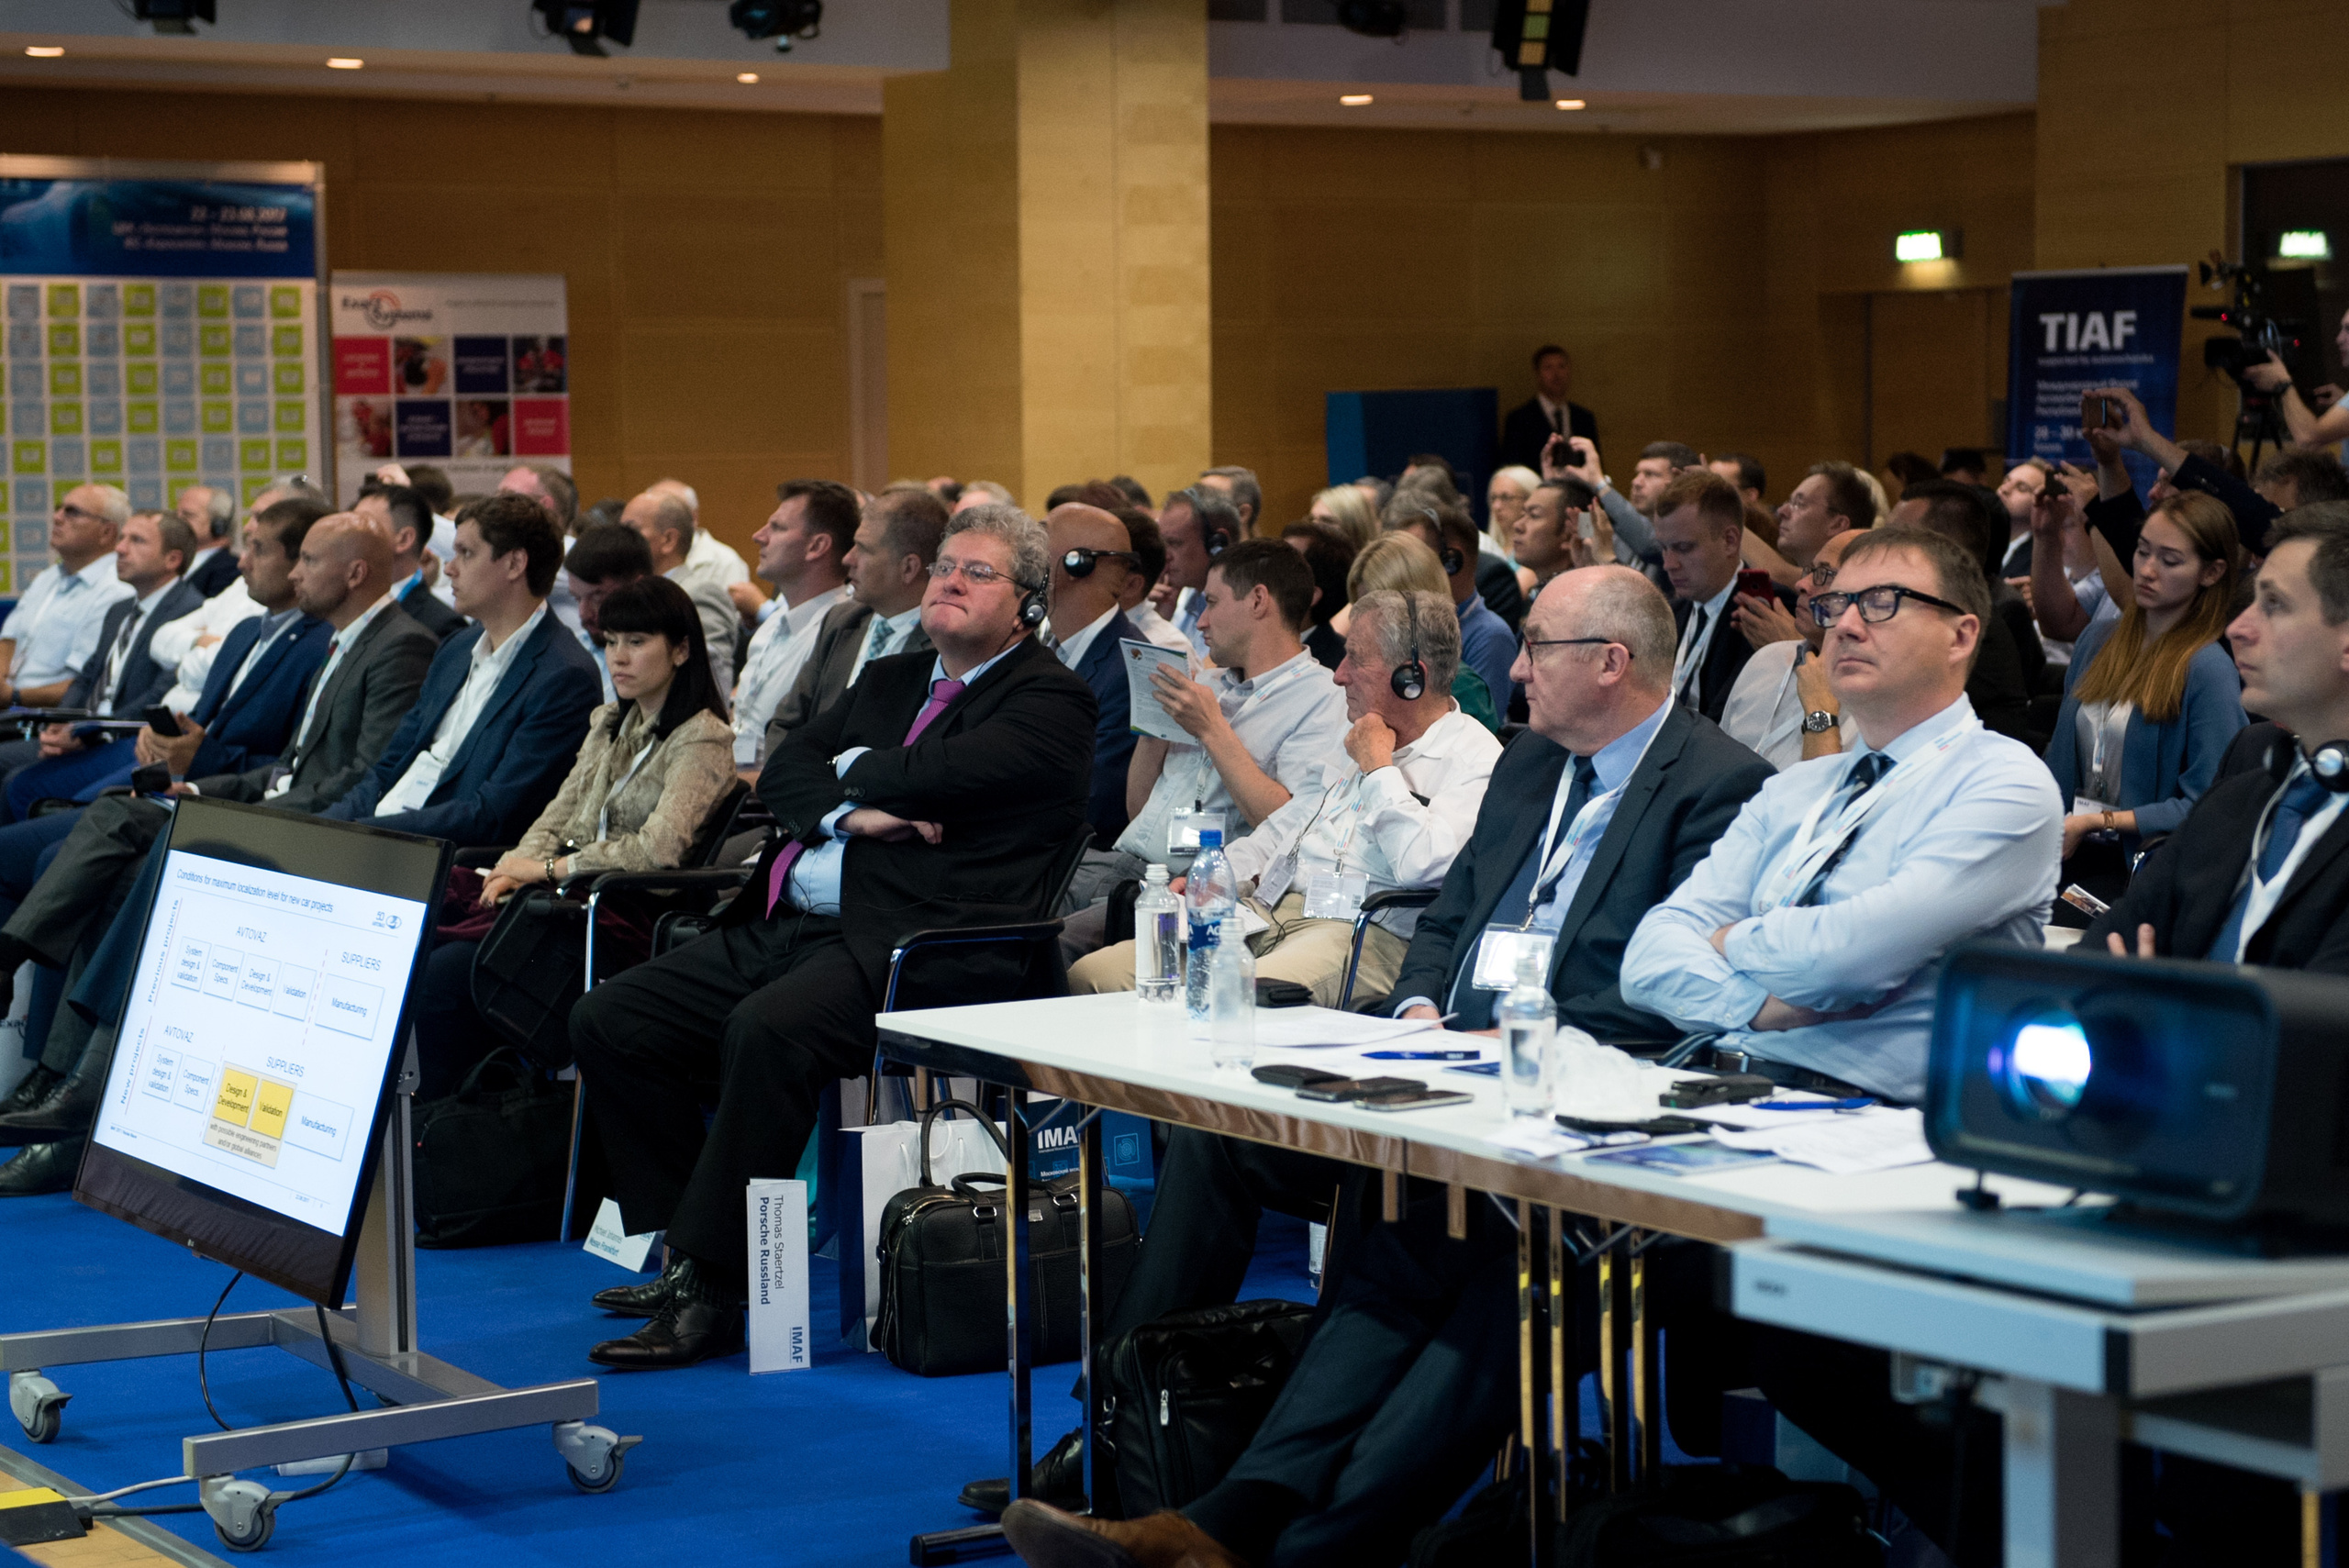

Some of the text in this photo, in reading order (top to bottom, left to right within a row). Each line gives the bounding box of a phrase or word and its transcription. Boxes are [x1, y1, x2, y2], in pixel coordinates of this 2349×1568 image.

[2039, 310, 2137, 352] TIAF
[177, 869, 203, 884] Conditions
[212, 878, 237, 890] maximum
[238, 882, 265, 897] localization
[266, 888, 279, 900] level
[288, 895, 300, 905] new
[301, 898, 310, 907] car
[310, 900, 333, 913] projects
[236, 926, 267, 943] AVTOVAZ
[147, 899, 179, 1003] Previous projects
[185, 945, 203, 957] System
[181, 959, 196, 971] design
[212, 959, 239, 973] Component
[341, 951, 382, 972] SUPPLIERS
[177, 972, 198, 984] validation
[249, 968, 266, 983] Design
[240, 980, 273, 996] Development
[283, 984, 306, 998] Validation
[331, 997, 367, 1018] Manufacturing
[164, 1025, 195, 1043] AVTOVAZ
[120, 1028, 145, 1105] New projects
[157, 1054, 173, 1066] System
[266, 1056, 305, 1077] SUPPLIERS
[152, 1067, 167, 1080] design
[184, 1069, 209, 1085] Component
[149, 1081, 169, 1093] validation
[226, 1083, 243, 1097] Design
[217, 1095, 249, 1113] Development
[260, 1101, 283, 1118] Validation
[301, 1116, 337, 1138] Manufacturing
[209, 1123, 277, 1152] with possible engineering partners
[1038, 1126, 1080, 1149] IMA
[217, 1139, 262, 1160] and/or global alliances
[759, 1196, 771, 1306] Porsche Russland
[774, 1195, 785, 1290] Thomas Staertzel
[792, 1326, 803, 1363] IMAF
